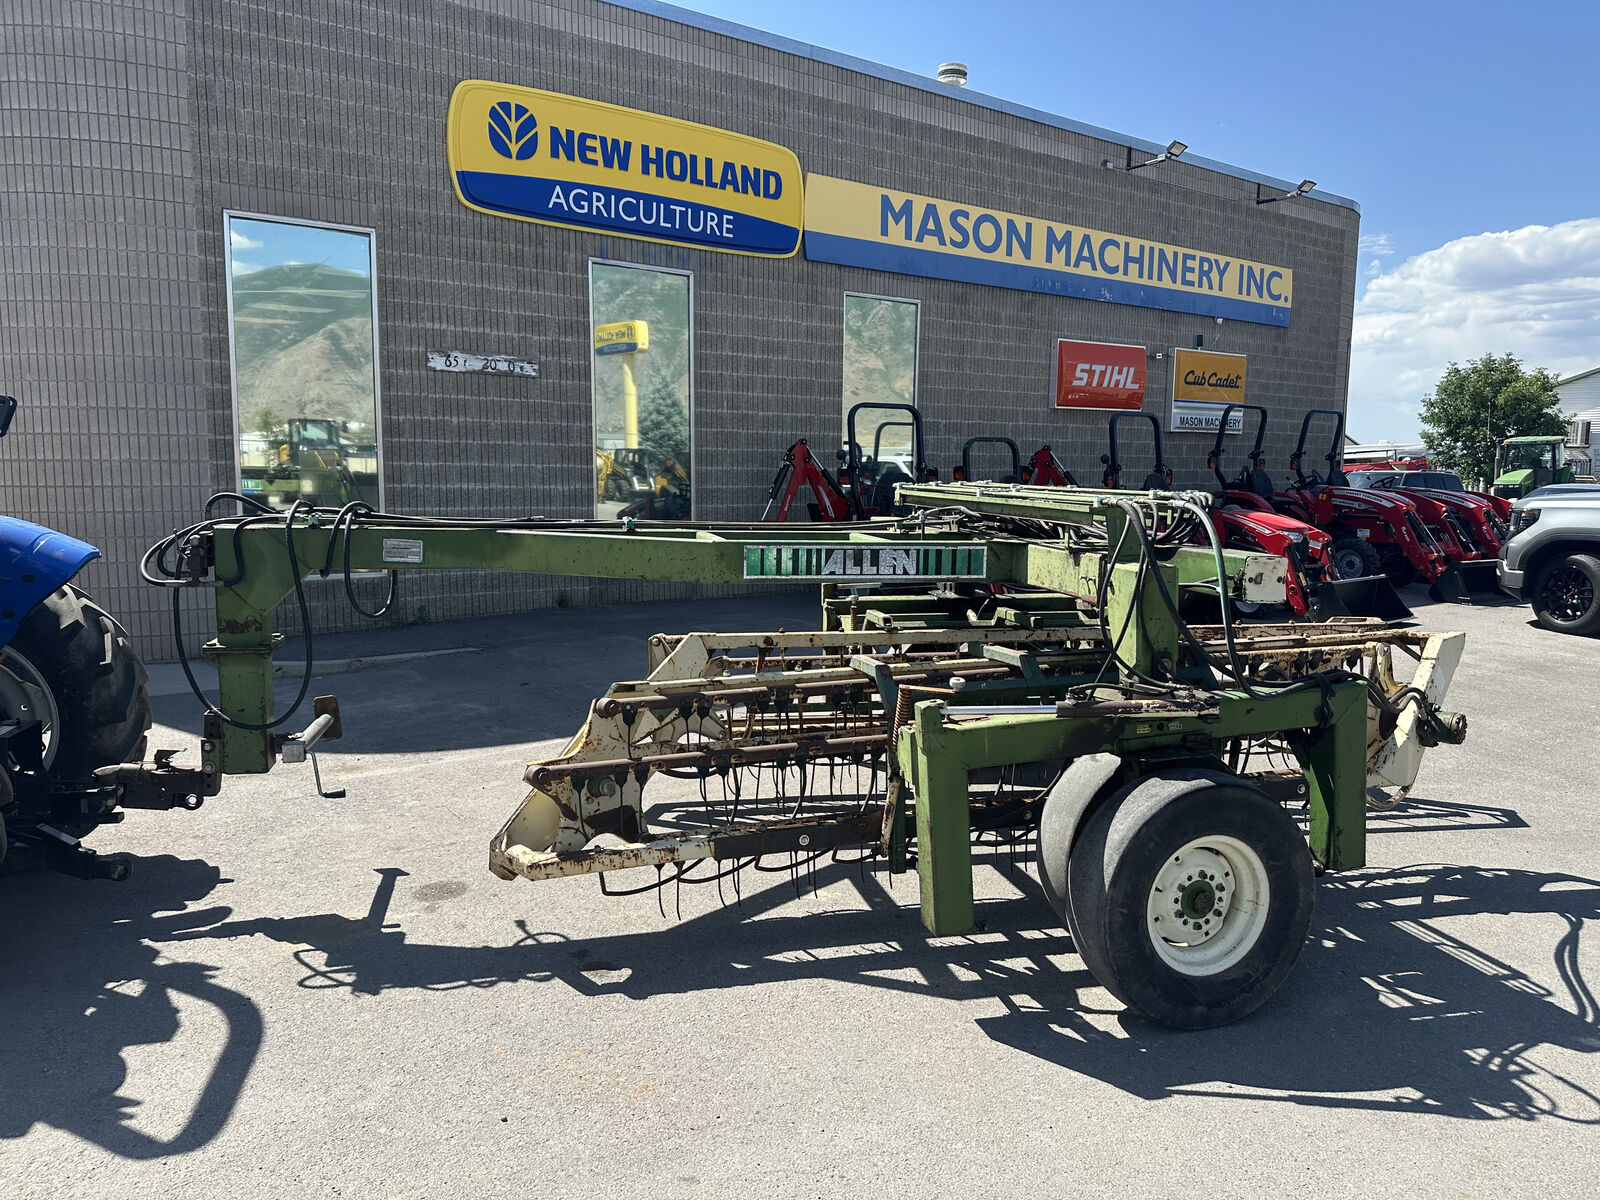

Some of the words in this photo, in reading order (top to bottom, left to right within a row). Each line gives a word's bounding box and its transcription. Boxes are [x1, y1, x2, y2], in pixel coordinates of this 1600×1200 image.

[549, 125, 633, 172] NEW
[641, 143, 783, 200] HOLLAND
[548, 184, 734, 238] AGRICULTURE
[880, 193, 1033, 260] MASON
[1045, 225, 1231, 292] MACHINERY
[1237, 262, 1290, 304] INC.
[1071, 363, 1140, 390] STIHL
[1184, 369, 1207, 386] Cub
[1207, 371, 1242, 389] Cadet
[1179, 415, 1204, 427] MASON
[821, 549, 918, 576] ALLEN
